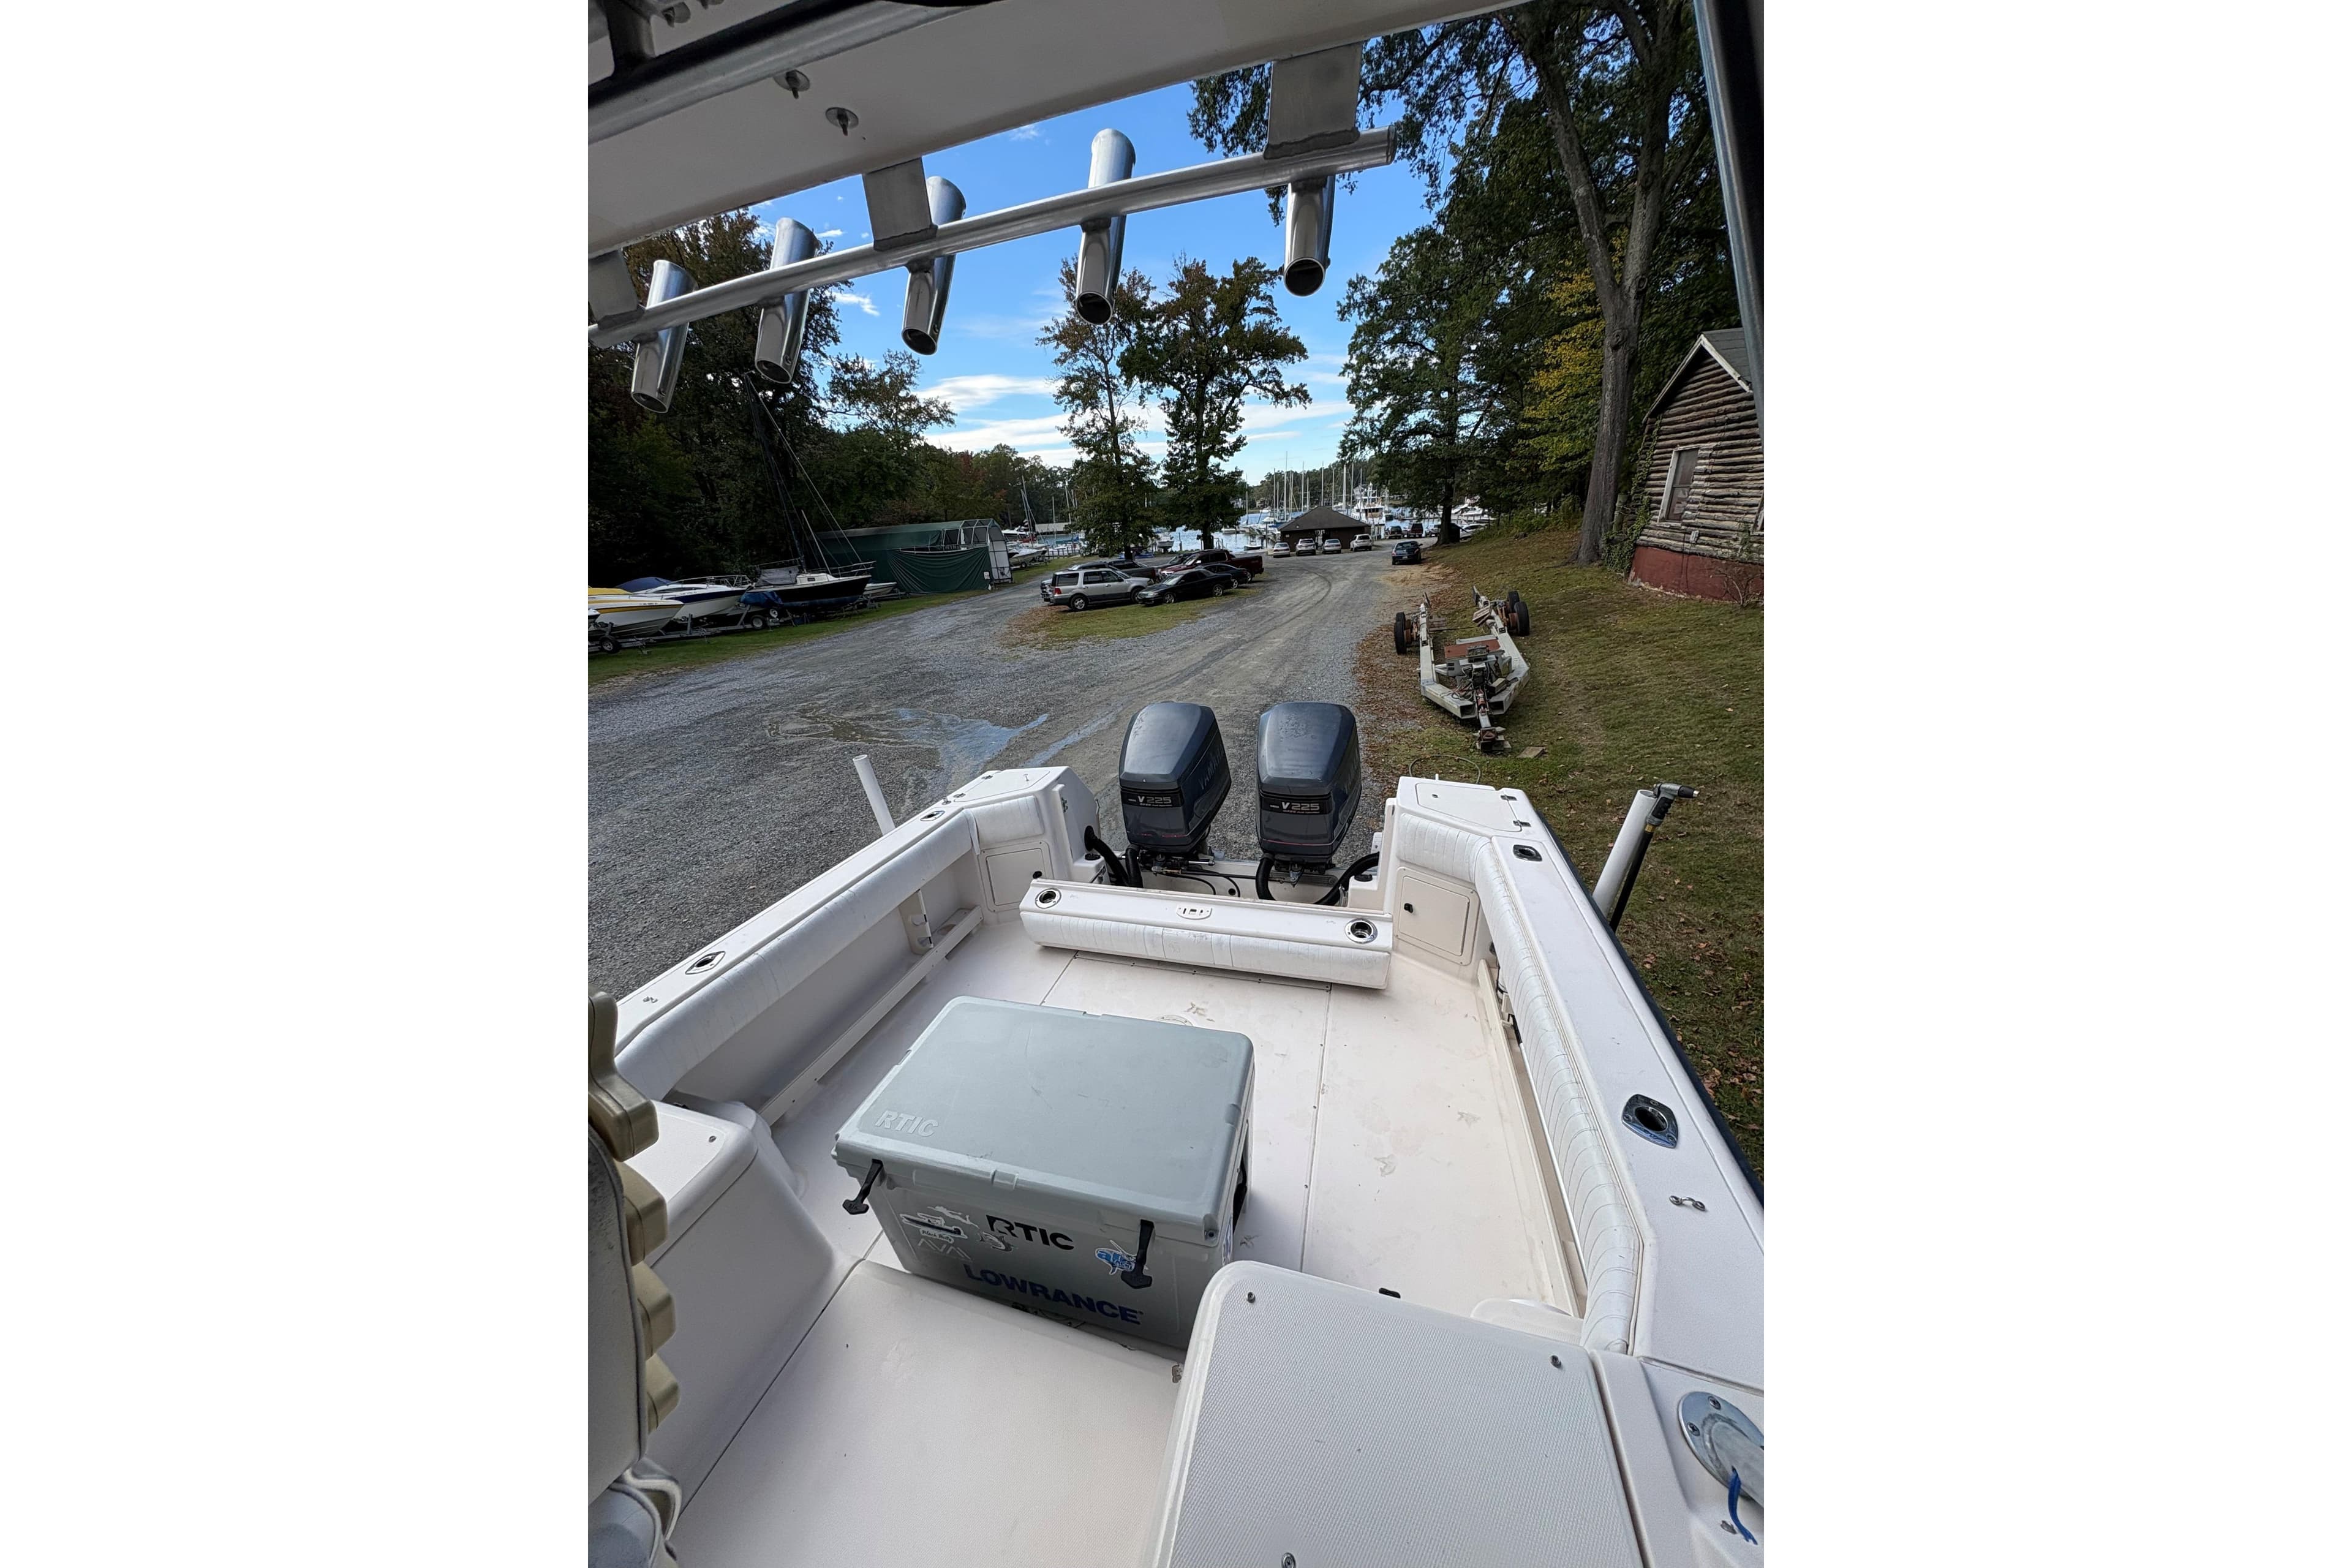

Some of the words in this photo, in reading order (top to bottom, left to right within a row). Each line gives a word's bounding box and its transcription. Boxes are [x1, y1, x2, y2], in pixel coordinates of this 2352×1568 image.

[875, 1110, 939, 1137] RTIC
[986, 1215, 1074, 1250] RTIC
[963, 1264, 1142, 1325] LOWRANCE
